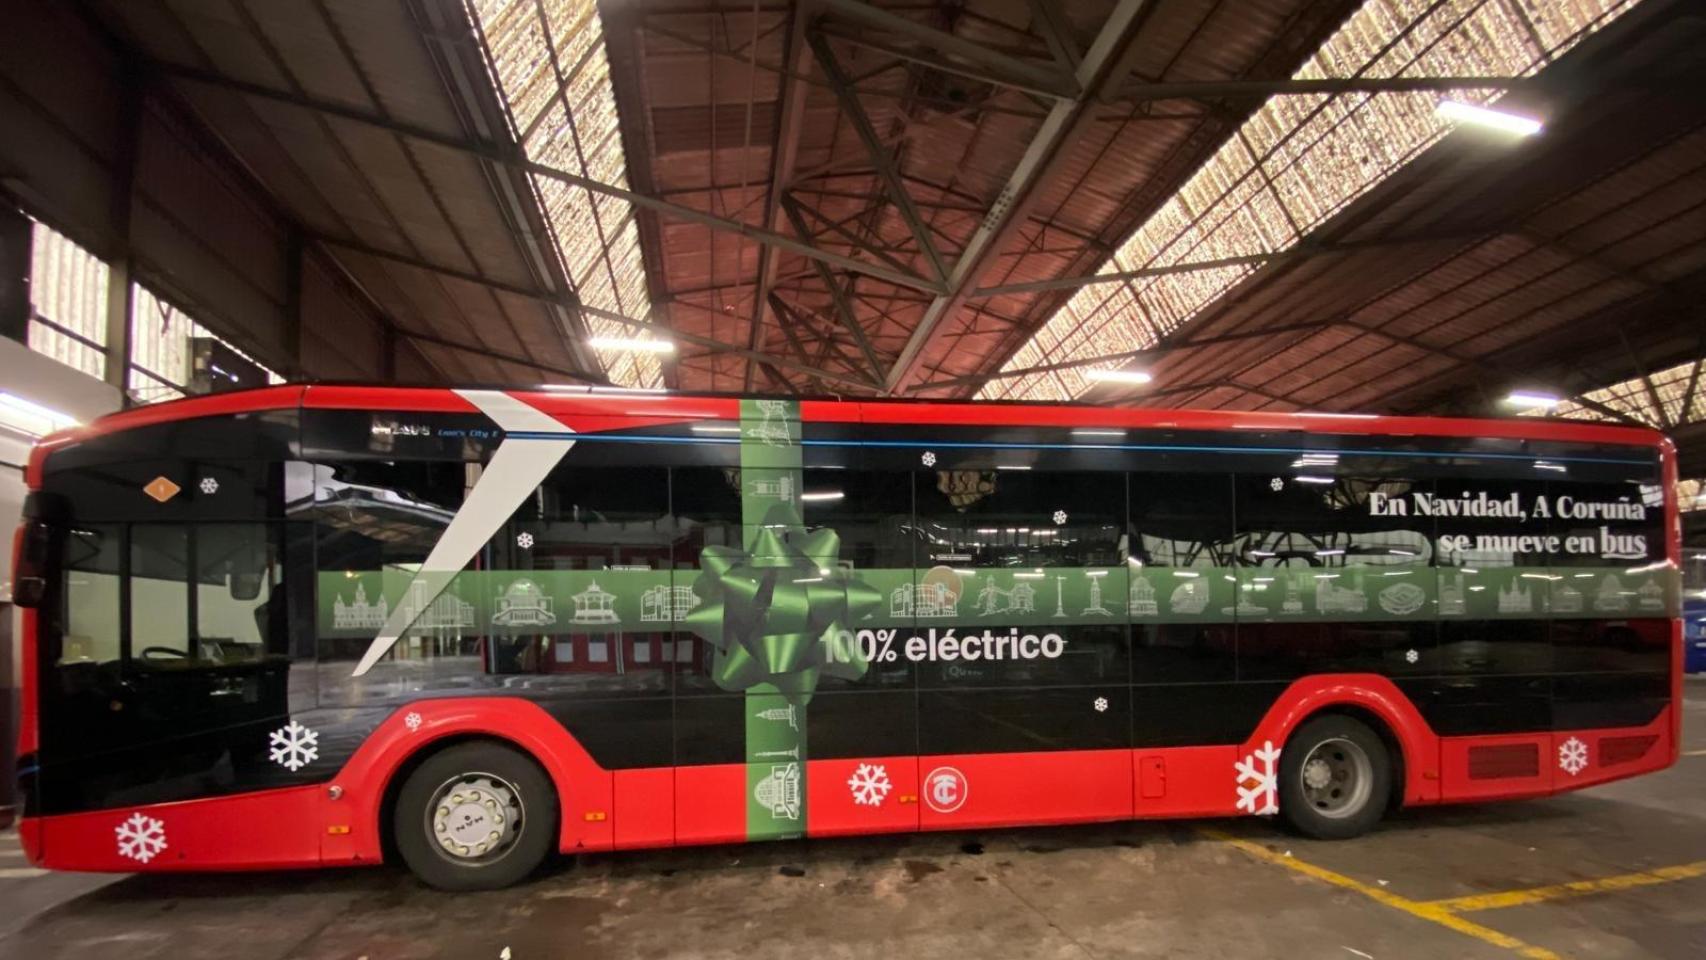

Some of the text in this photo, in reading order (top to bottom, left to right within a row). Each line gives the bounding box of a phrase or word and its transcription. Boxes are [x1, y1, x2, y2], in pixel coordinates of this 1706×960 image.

[1369, 490, 1646, 522] En Navidad, A Coruña
[1440, 526, 1647, 559] se mueve en bus
[819, 628, 1065, 663] 100% eléctrico
